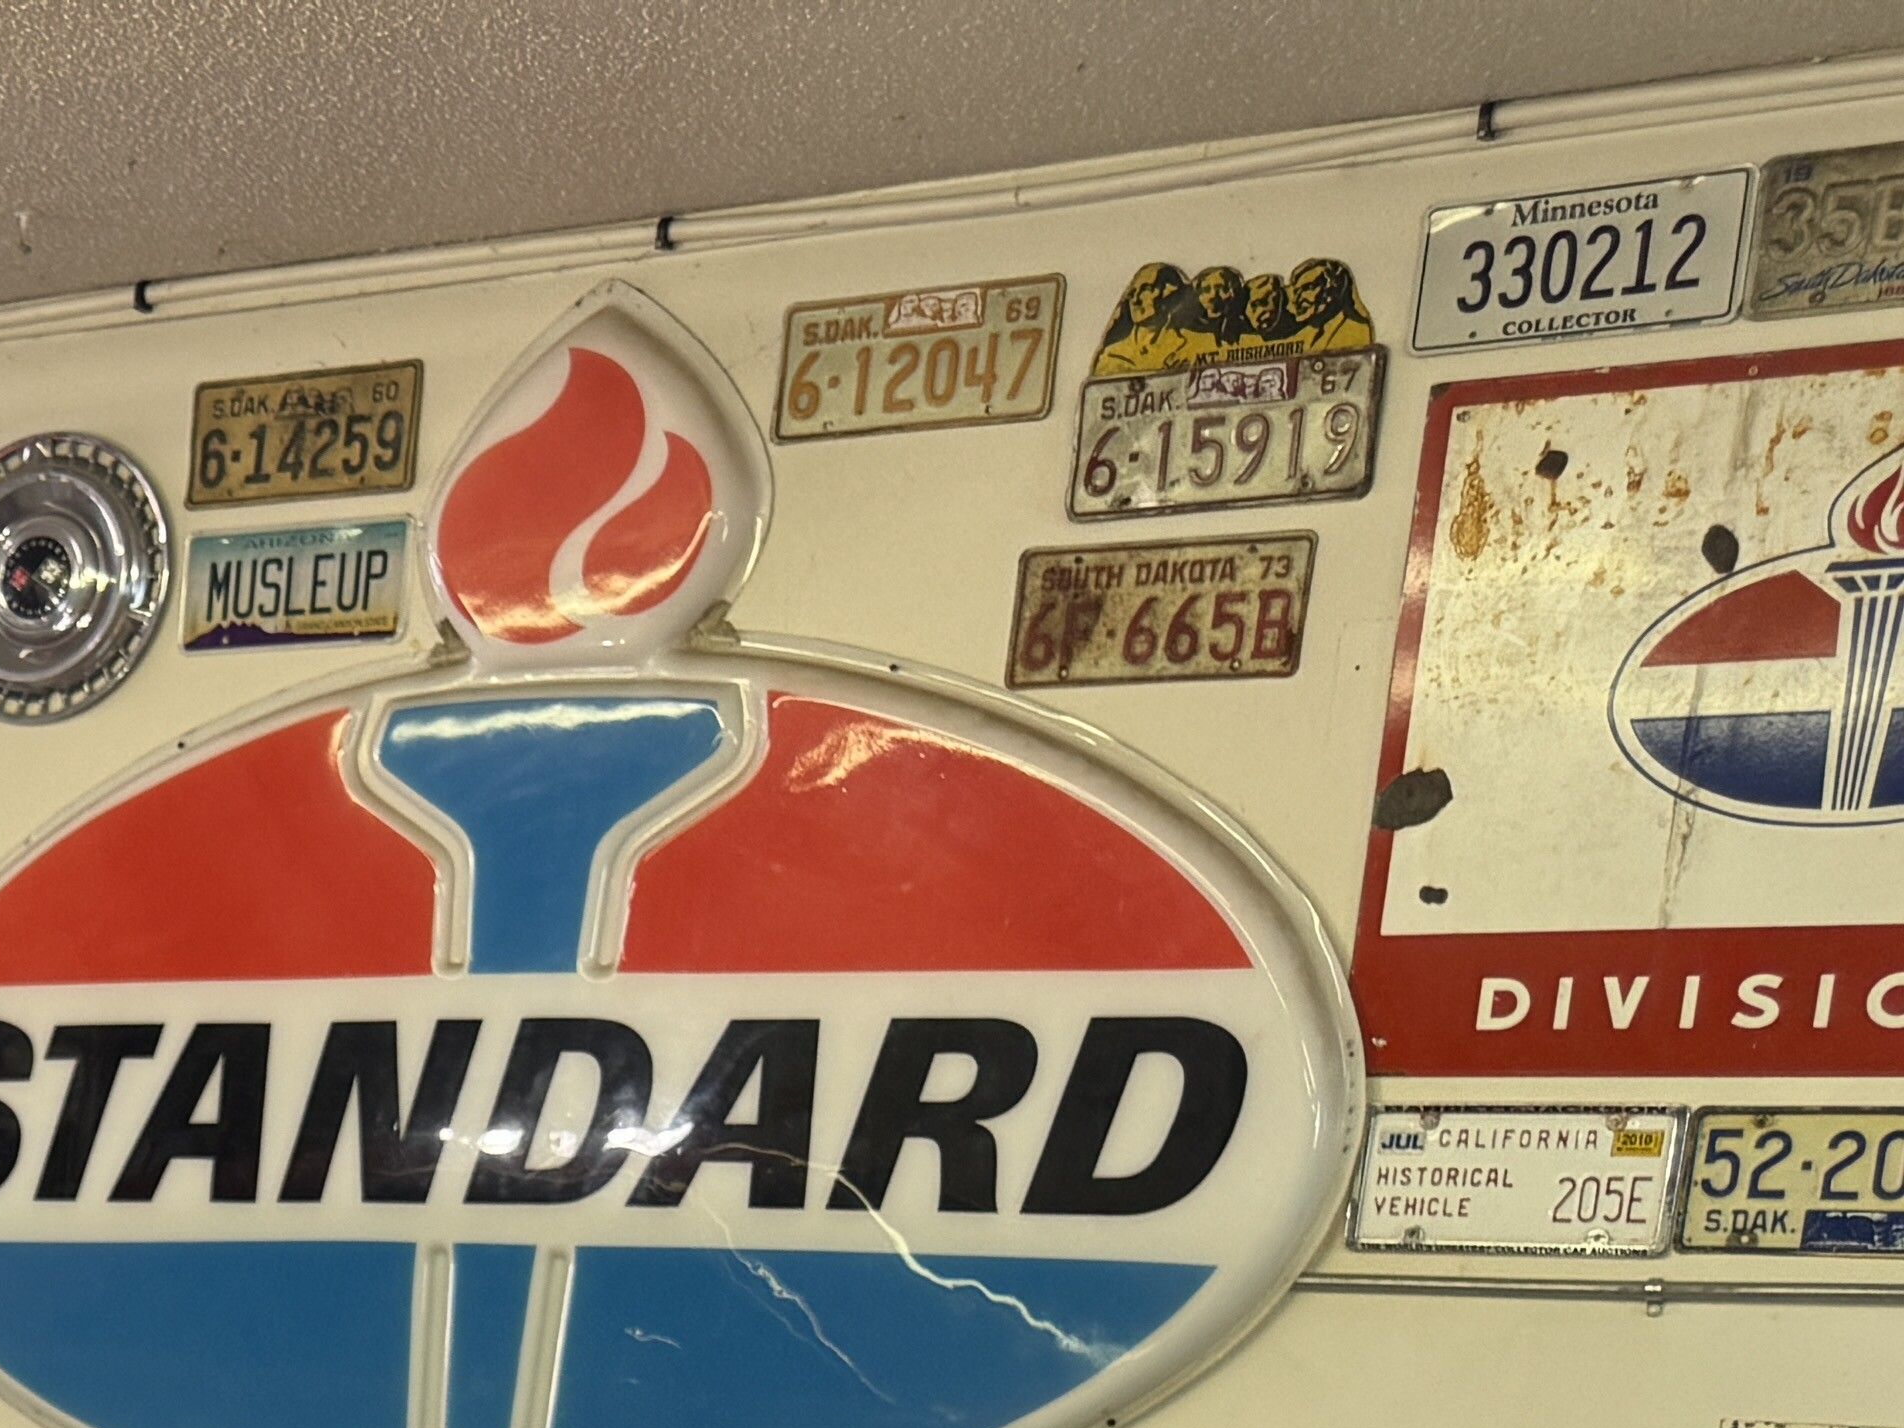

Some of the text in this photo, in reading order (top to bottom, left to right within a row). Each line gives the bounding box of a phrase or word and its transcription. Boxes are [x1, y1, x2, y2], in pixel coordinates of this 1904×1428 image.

[1512, 190, 1660, 229] Minnesota
[1456, 212, 1708, 315] 330212
[1005, 296, 1041, 324] 69
[1502, 307, 1637, 338] COLLECTOR
[372, 379, 400, 404] 60
[1320, 367, 1360, 395] 67
[206, 549, 388, 623] MUSLEUP
[1041, 555, 1292, 593] SOUTH DAKOTA 73
[1380, 1133, 1424, 1150] JUL
[1438, 1128, 1599, 1150] CALIFORNIA
[1375, 1166, 1514, 1189] HISTORICAL
[1374, 1196, 1472, 1218] VEHICLE
[1551, 1175, 1654, 1225] 205E
[1704, 1208, 1796, 1234] S.DAK.
[1563, 1246, 1587, 1256] CAR
[1589, 1246, 1649, 1257] AUCTIONS
